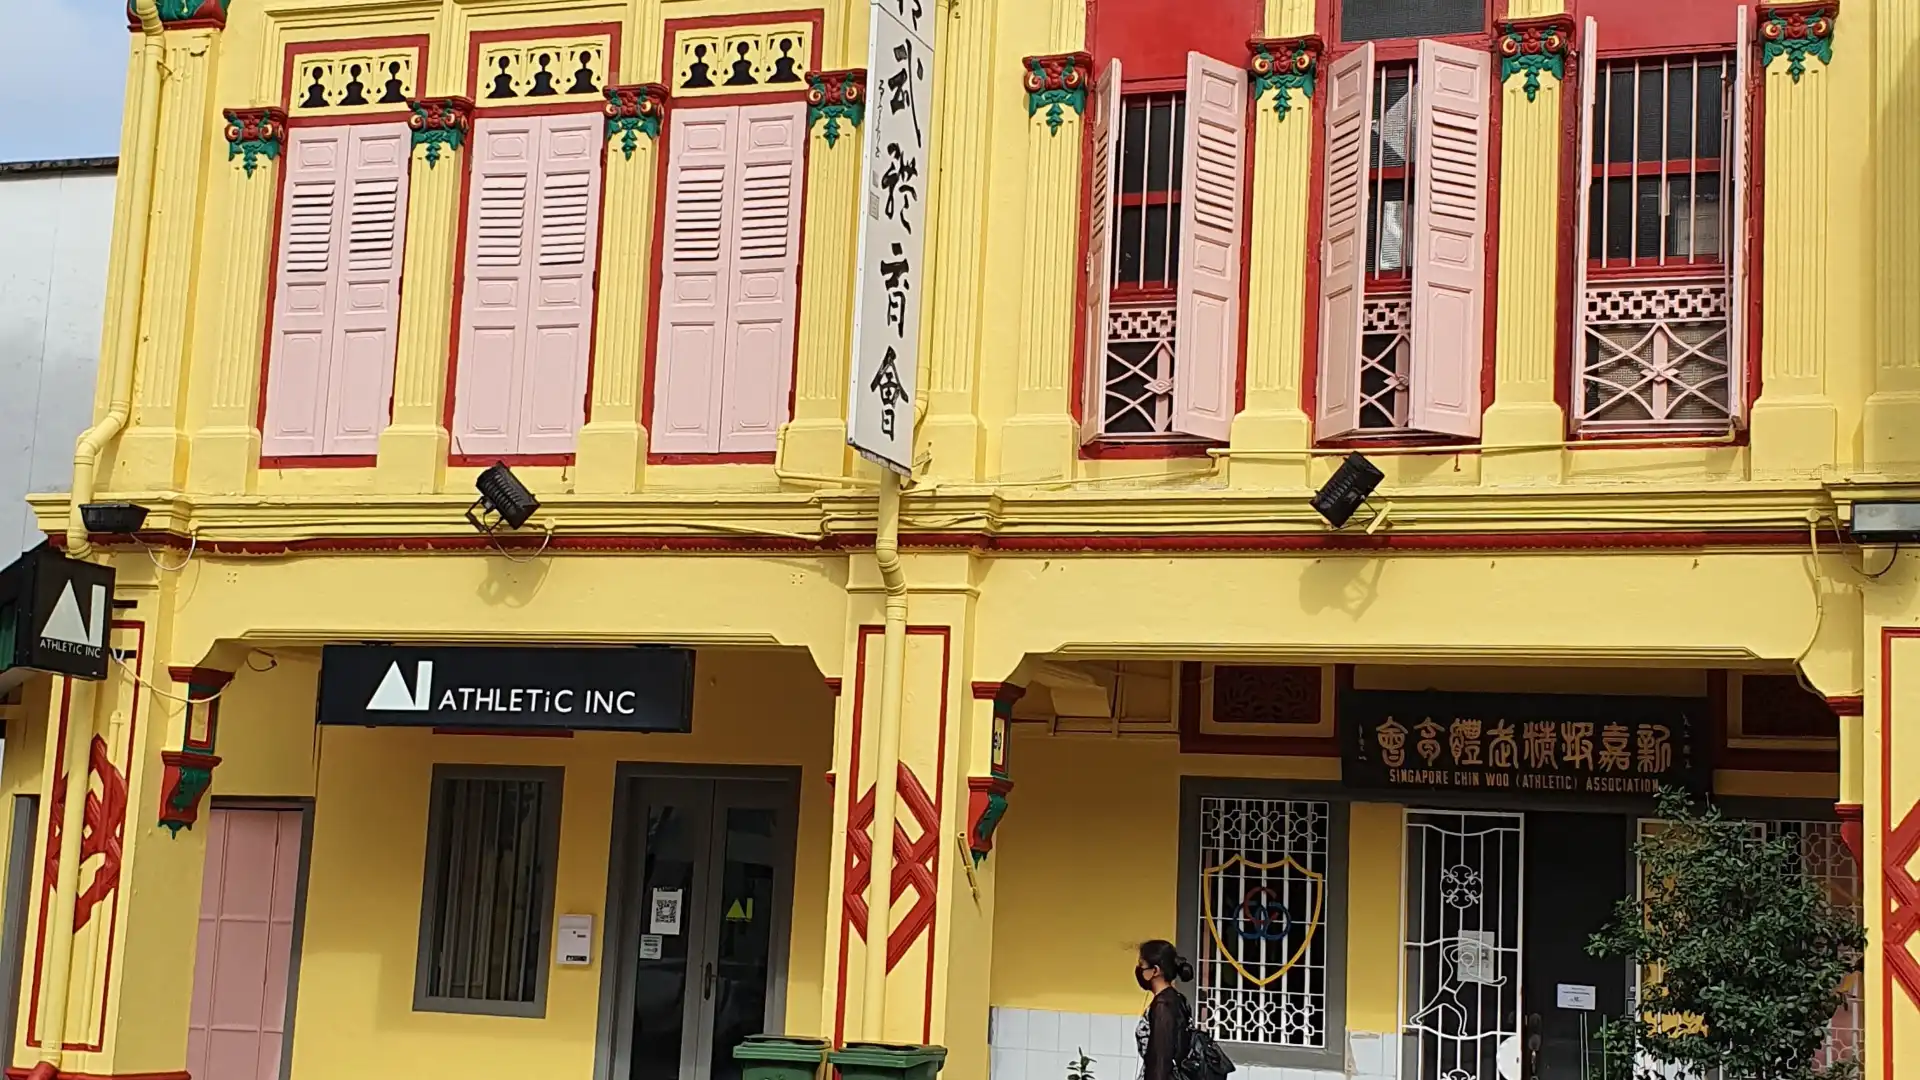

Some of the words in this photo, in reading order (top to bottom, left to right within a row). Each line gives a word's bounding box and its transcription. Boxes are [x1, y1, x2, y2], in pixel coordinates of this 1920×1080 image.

[85, 647, 101, 658] INC
[584, 690, 636, 714] INC
[1389, 768, 1449, 785] SINGAPORE
[1454, 771, 1480, 786] CHIN
[1484, 772, 1509, 787] WOO
[1515, 773, 1578, 790] (ATHLETIC)
[1585, 776, 1659, 793] ASSOCIATION
